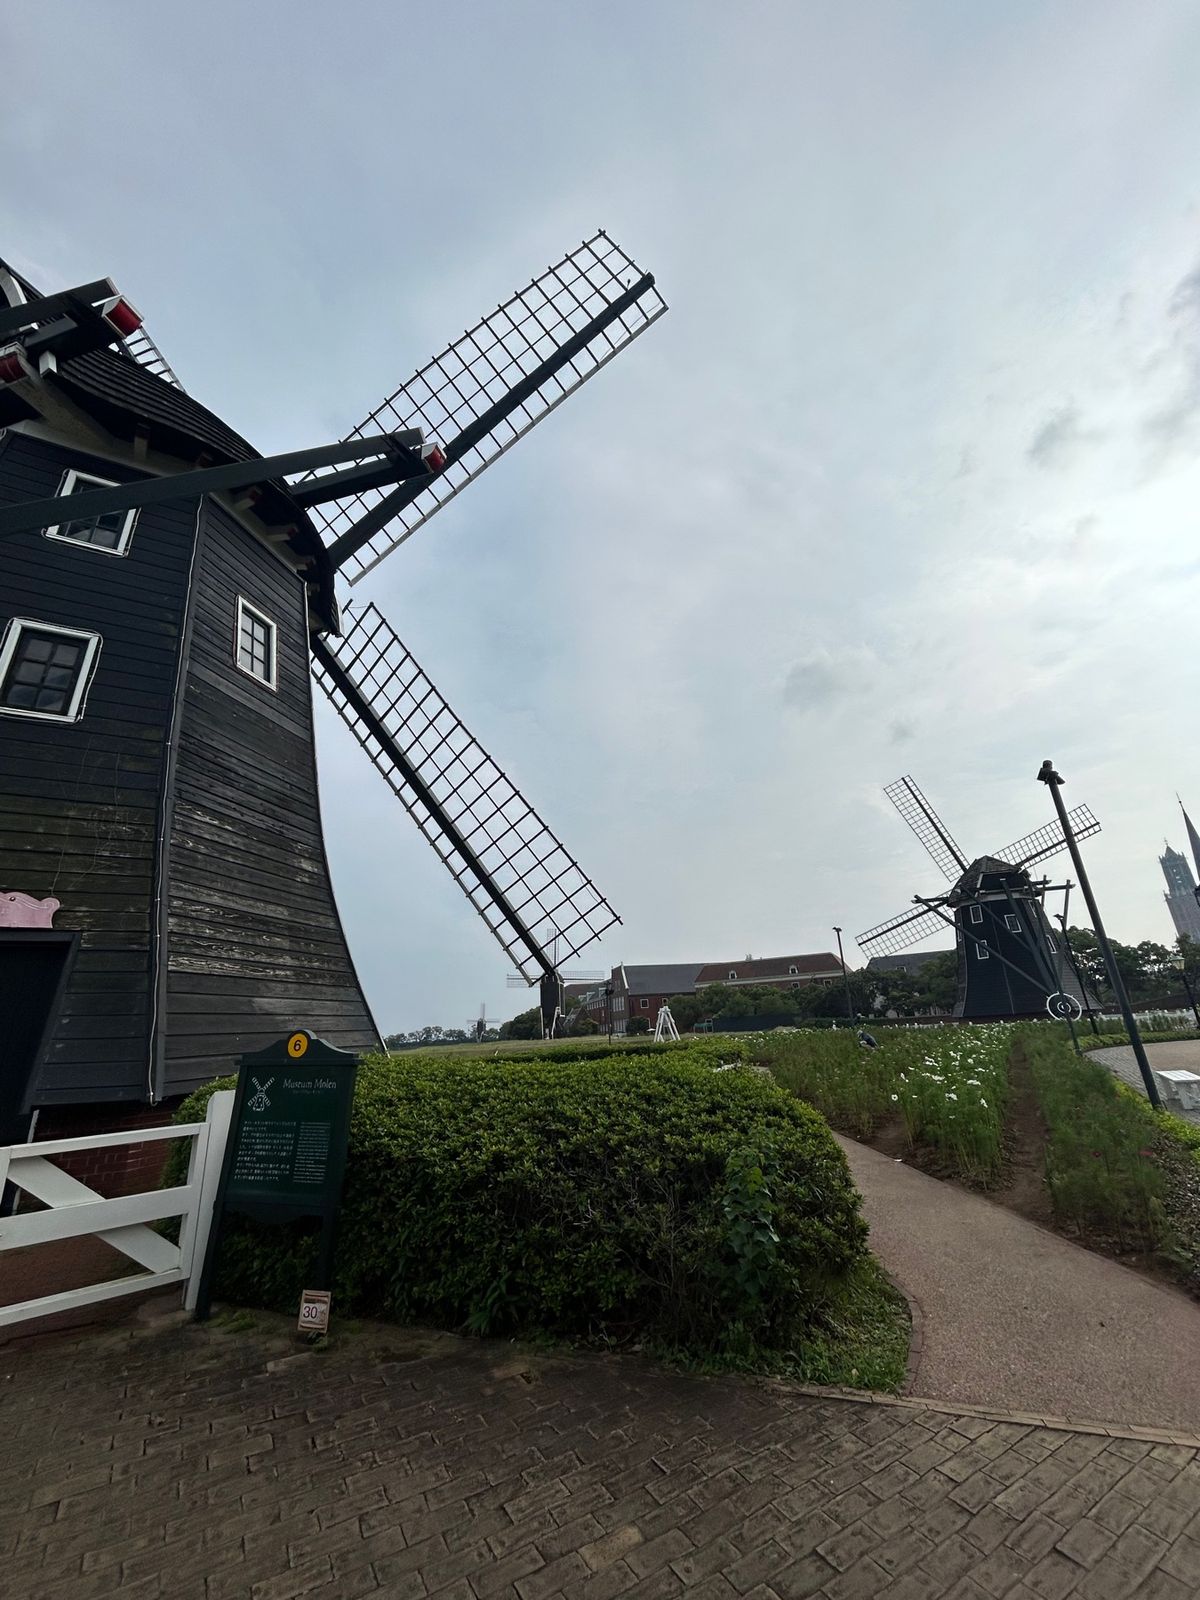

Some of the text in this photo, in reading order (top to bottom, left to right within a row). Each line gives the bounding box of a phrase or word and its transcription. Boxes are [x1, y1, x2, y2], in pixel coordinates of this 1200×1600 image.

[293, 1039, 302, 1052] 6
[282, 1078, 337, 1089] Museum Molen
[302, 1305, 318, 1319] 30
